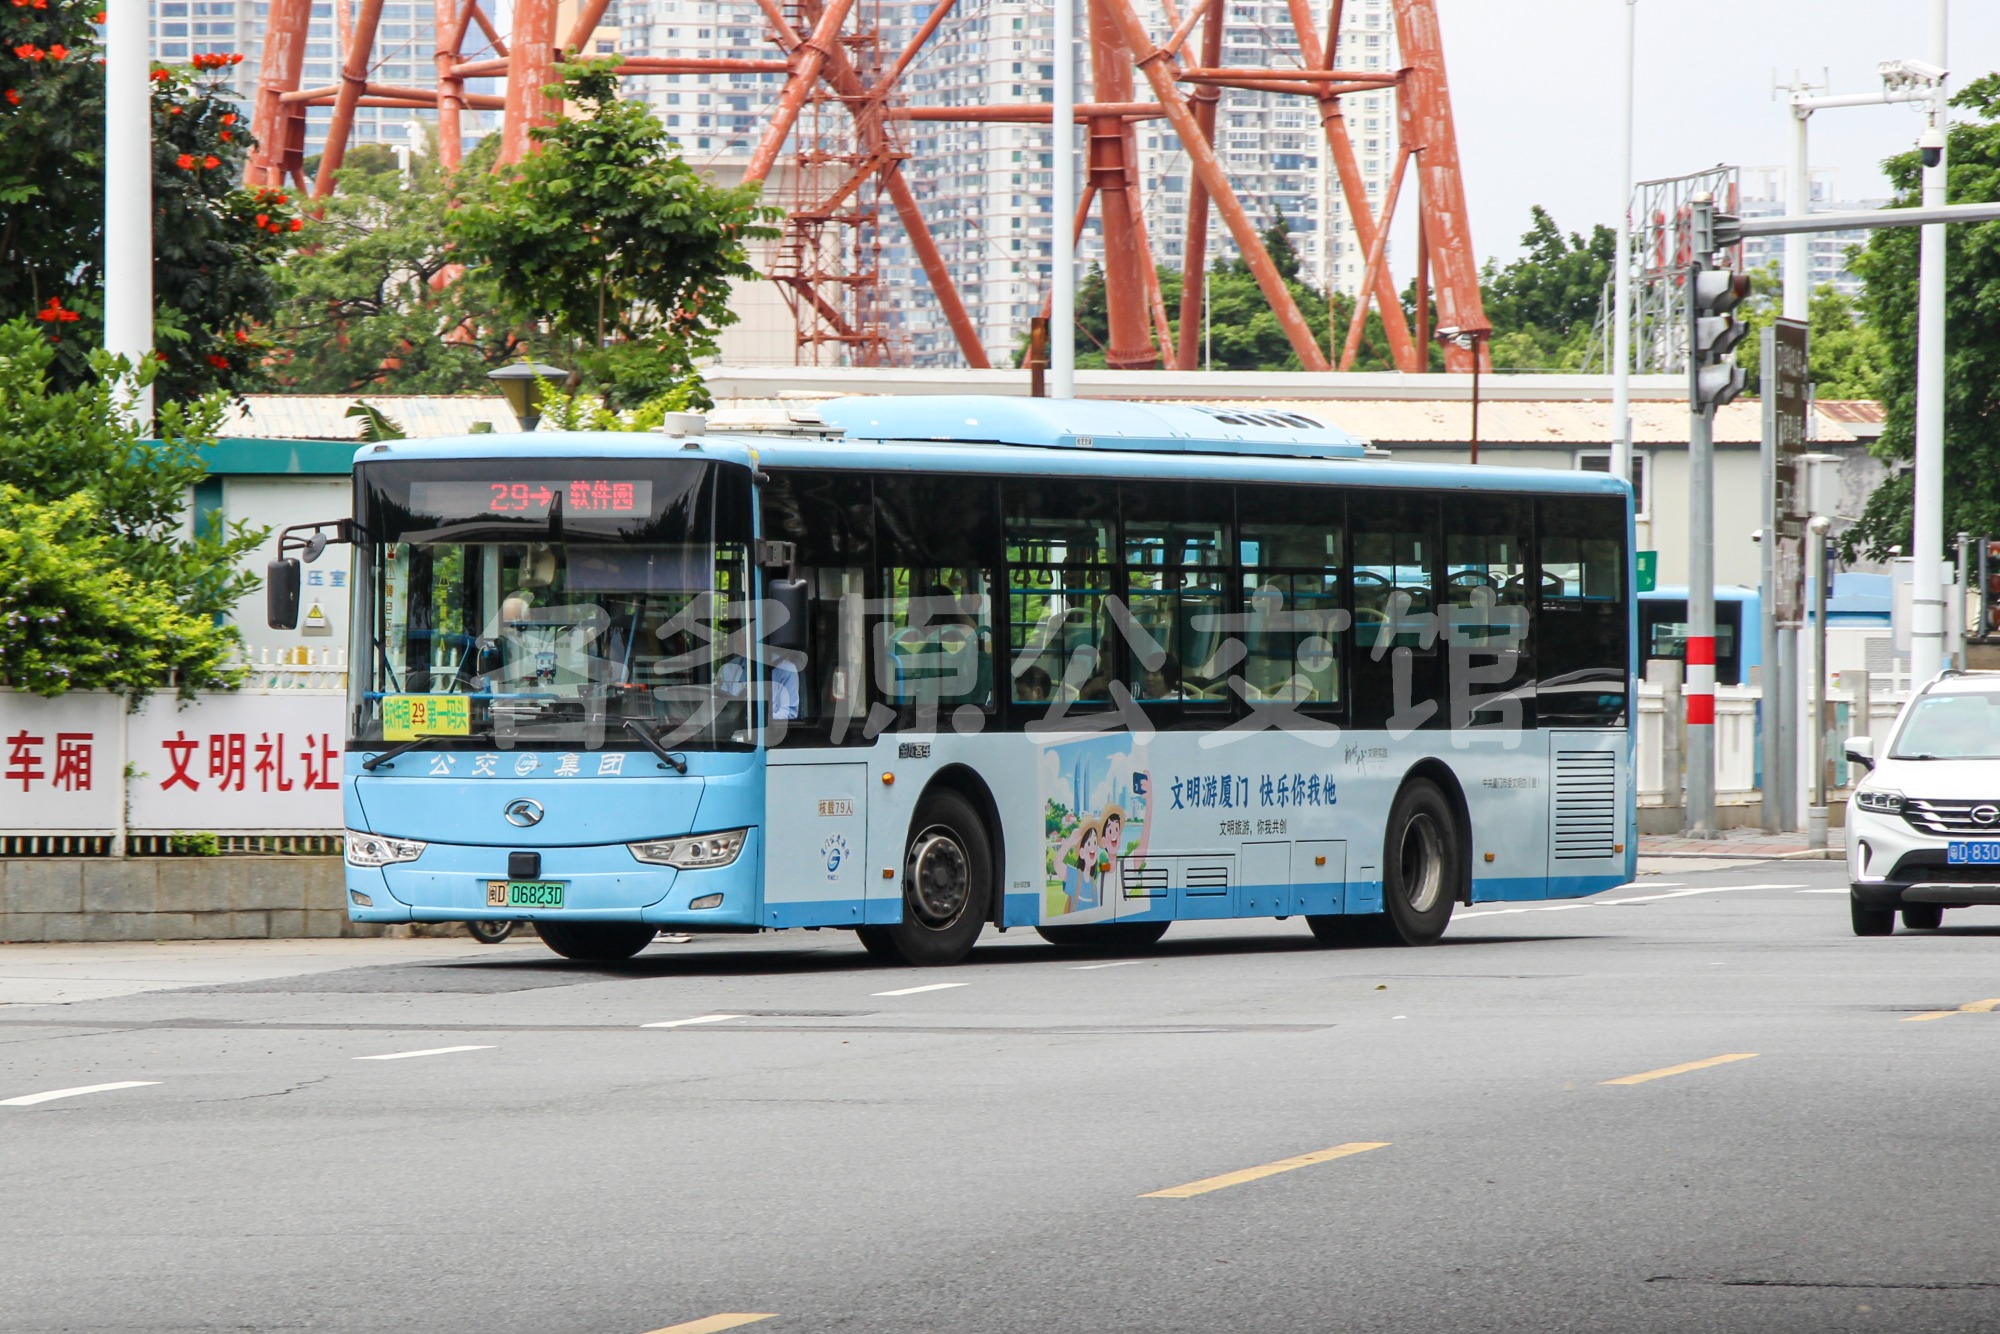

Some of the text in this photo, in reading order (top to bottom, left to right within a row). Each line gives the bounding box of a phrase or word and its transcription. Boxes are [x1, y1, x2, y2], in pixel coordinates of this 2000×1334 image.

[490, 479, 634, 511] 29 软件园
[412, 703, 425, 718] 29
[4, 730, 94, 793] 车厢
[160, 730, 340, 793] 文明礼让
[818, 801, 853, 815] 核载79人
[1170, 773, 1338, 811] 文明游厦门 快乐你我他
